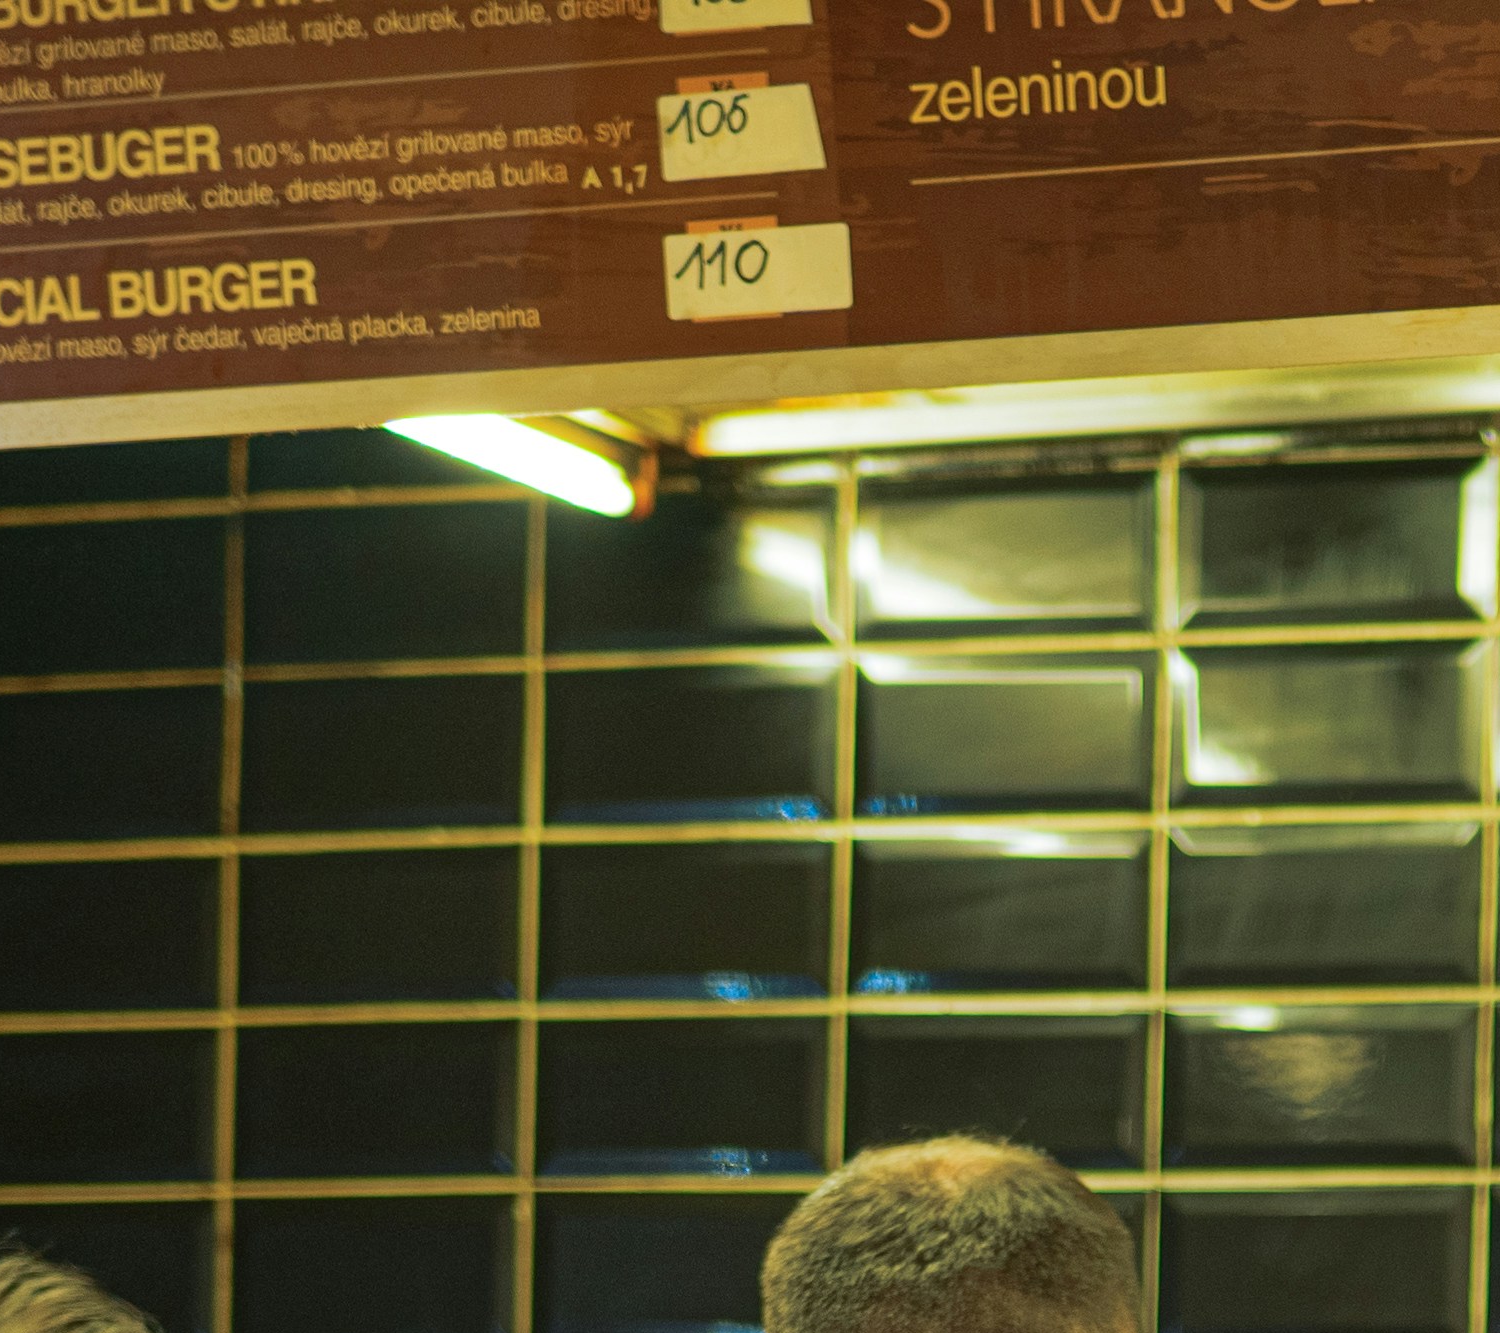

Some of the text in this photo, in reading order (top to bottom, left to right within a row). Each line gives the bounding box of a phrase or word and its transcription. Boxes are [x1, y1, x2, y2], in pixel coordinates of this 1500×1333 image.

[374, 5, 466, 37] okurek,
[62, 65, 166, 99] hranolky
[909, 59, 1167, 123] zeleninou
[231, 142, 304, 171] 100%
[309, 131, 390, 168] hovězí
[396, 124, 508, 164] grilované
[513, 125, 589, 152] maso,
[107, 188, 199, 217] okurek,
[203, 181, 280, 209] cibule,
[285, 176, 381, 206] dresing,
[389, 164, 496, 200] opečená
[501, 159, 569, 187] bulka
[581, 166, 603, 190] A
[611, 164, 648, 195] 1,7
[107, 258, 318, 320] BURGER
[674, 238, 769, 291] 110
[56, 333, 128, 359] maso,
[349, 306, 435, 345] placka,
[440, 306, 541, 335] zelenina
